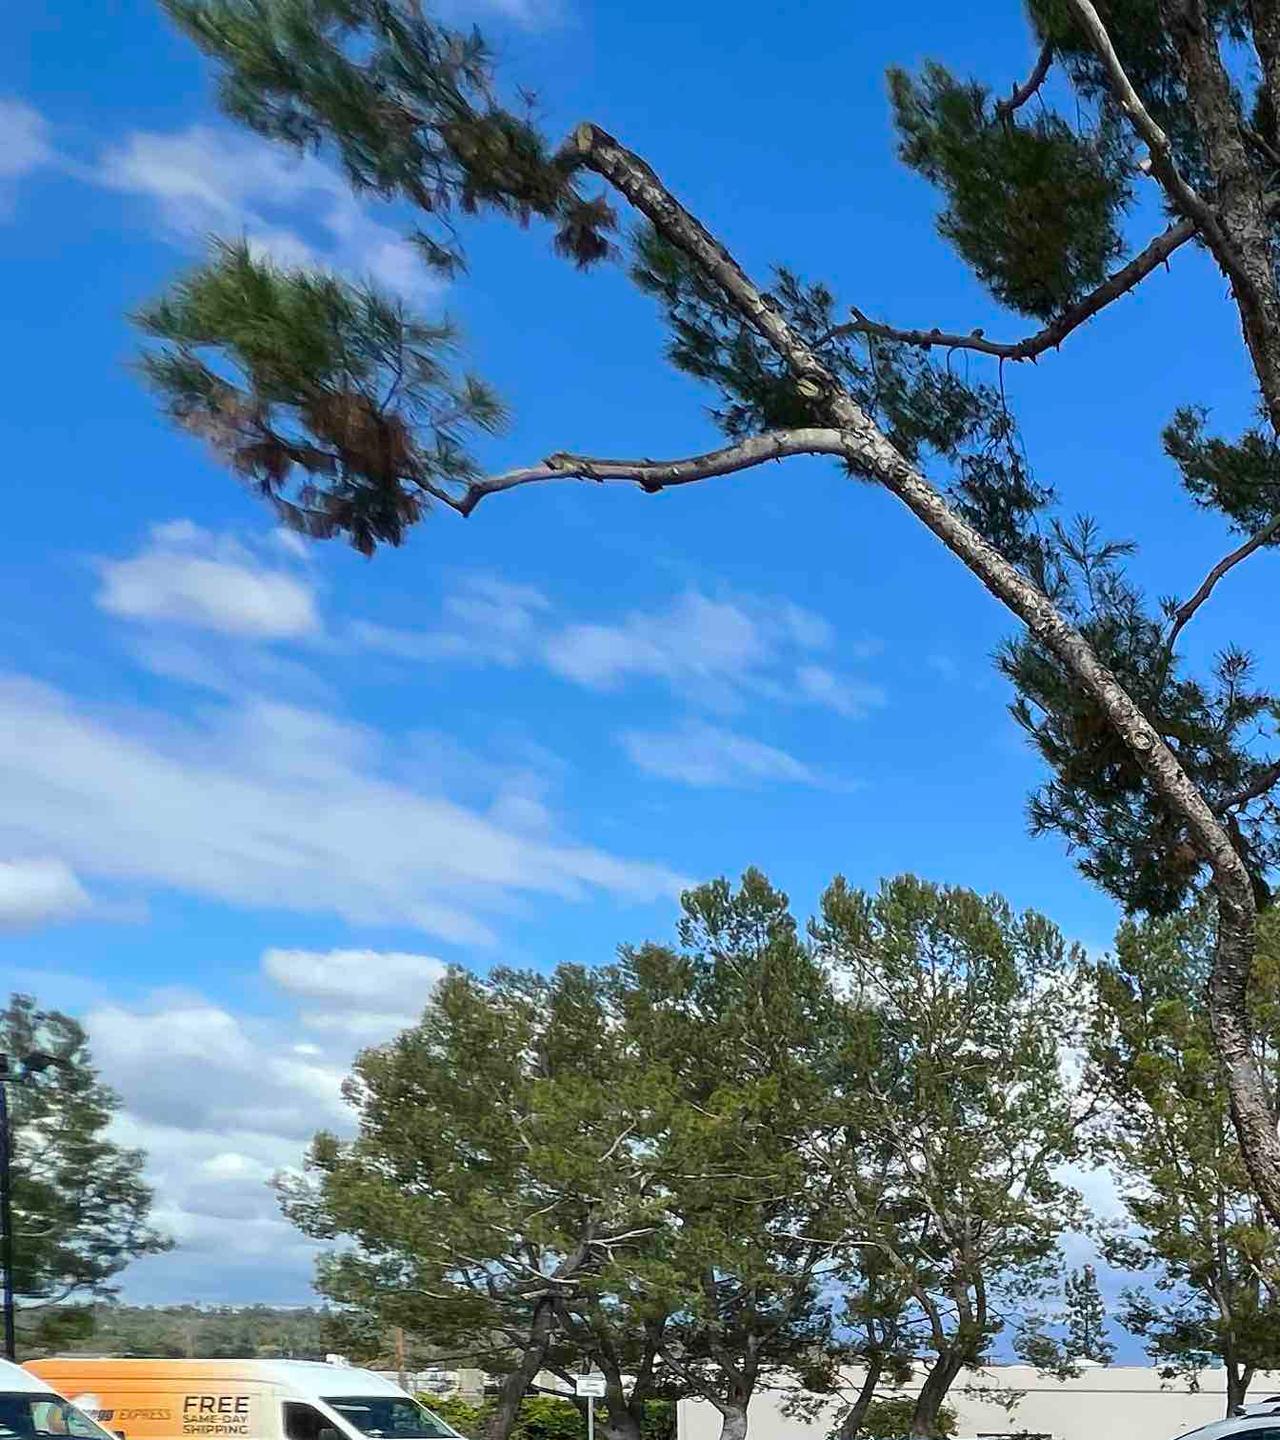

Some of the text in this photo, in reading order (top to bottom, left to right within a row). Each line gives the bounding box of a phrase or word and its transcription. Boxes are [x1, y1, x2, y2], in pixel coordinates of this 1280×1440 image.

[183, 1395, 250, 1413] FREE
[118, 1408, 172, 1420] EXPRESS
[183, 1414, 248, 1424] SAME-DAY
[182, 1425, 248, 1435] SHIPPING
